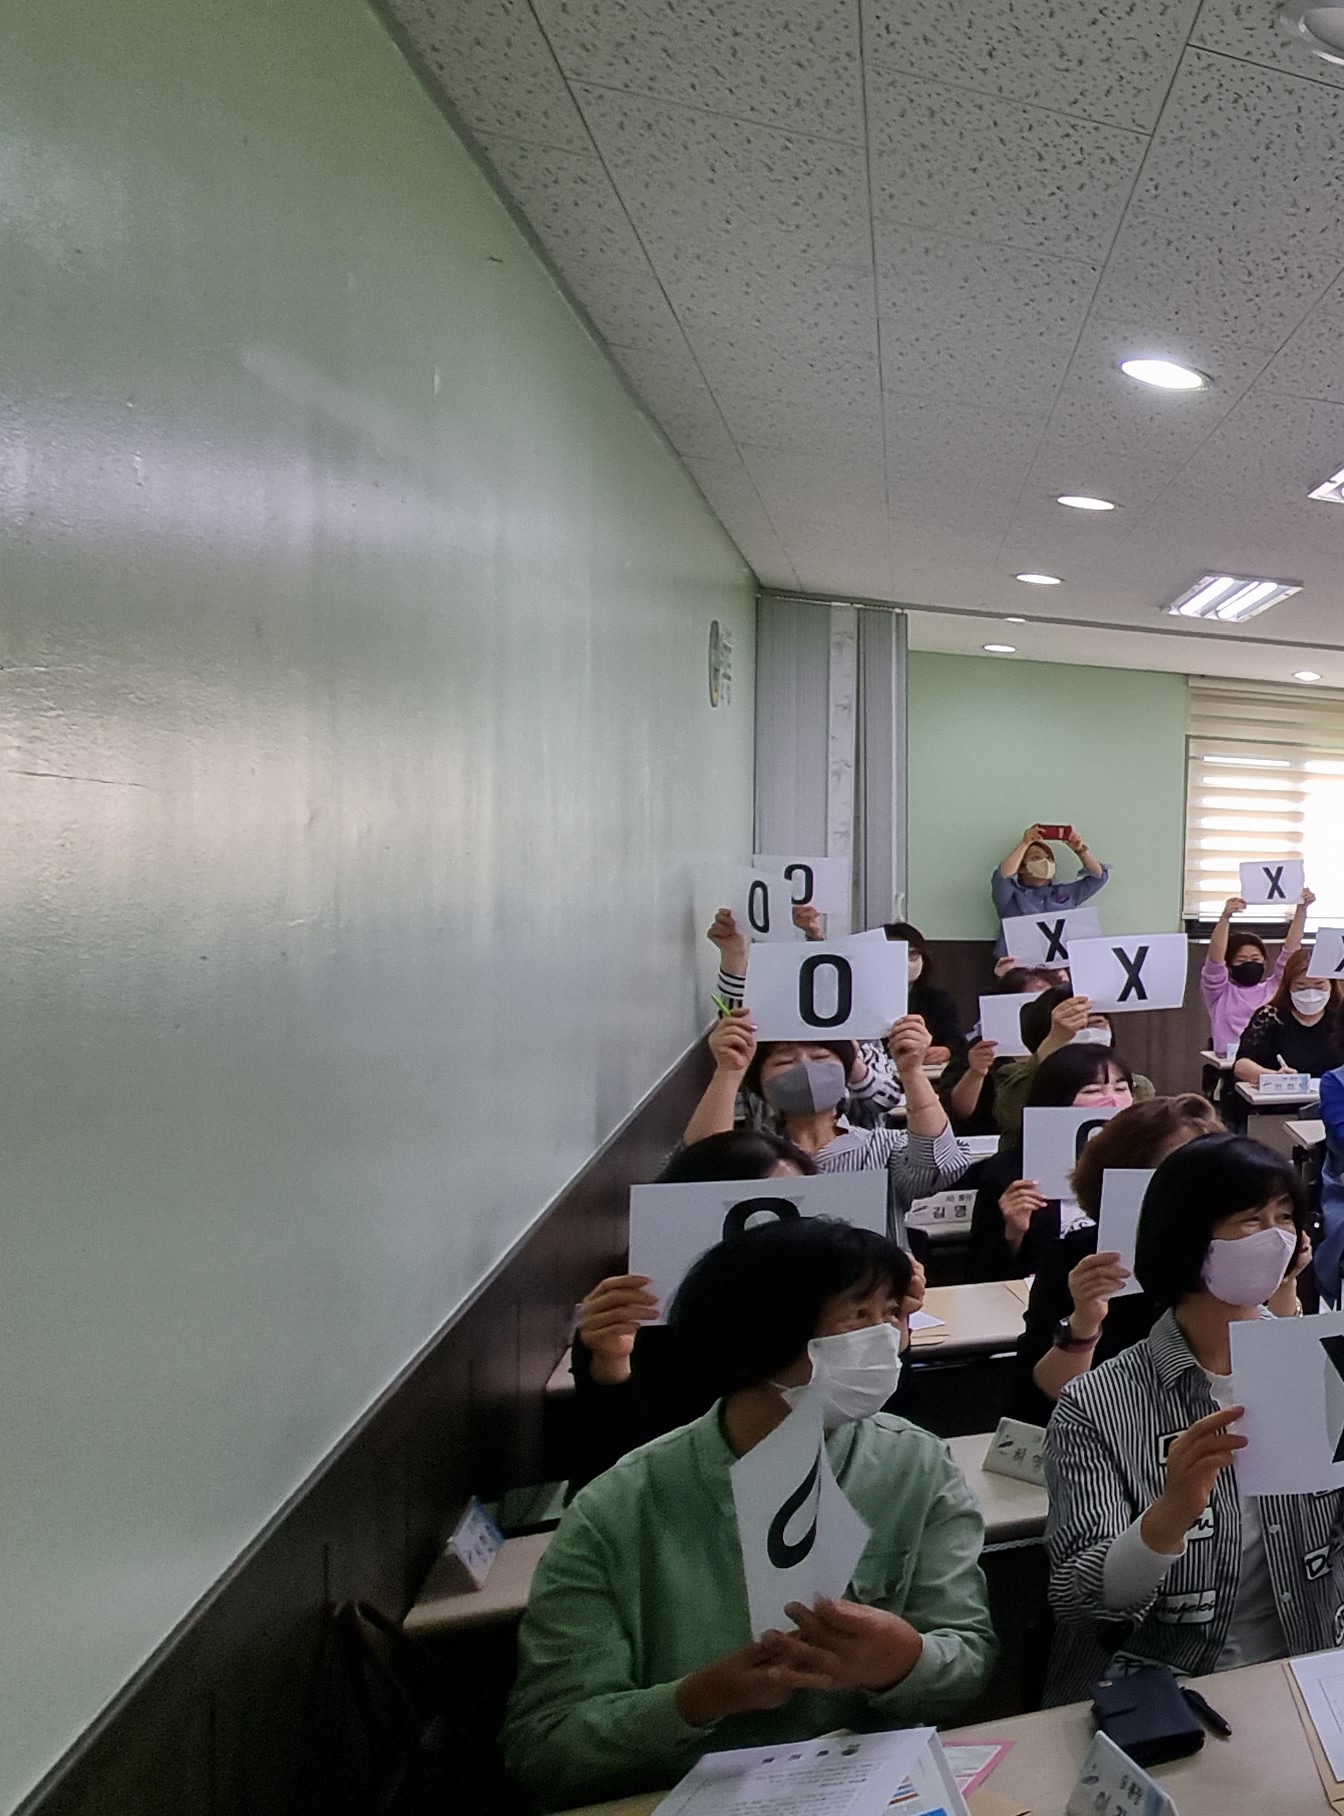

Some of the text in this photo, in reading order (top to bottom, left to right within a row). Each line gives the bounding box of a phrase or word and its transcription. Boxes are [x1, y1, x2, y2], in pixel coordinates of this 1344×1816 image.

[748, 880, 769, 933] O
[1262, 866, 1286, 899] X
[1036, 918, 1069, 963] X
[799, 954, 852, 1028] O
[1111, 946, 1149, 1002] X
